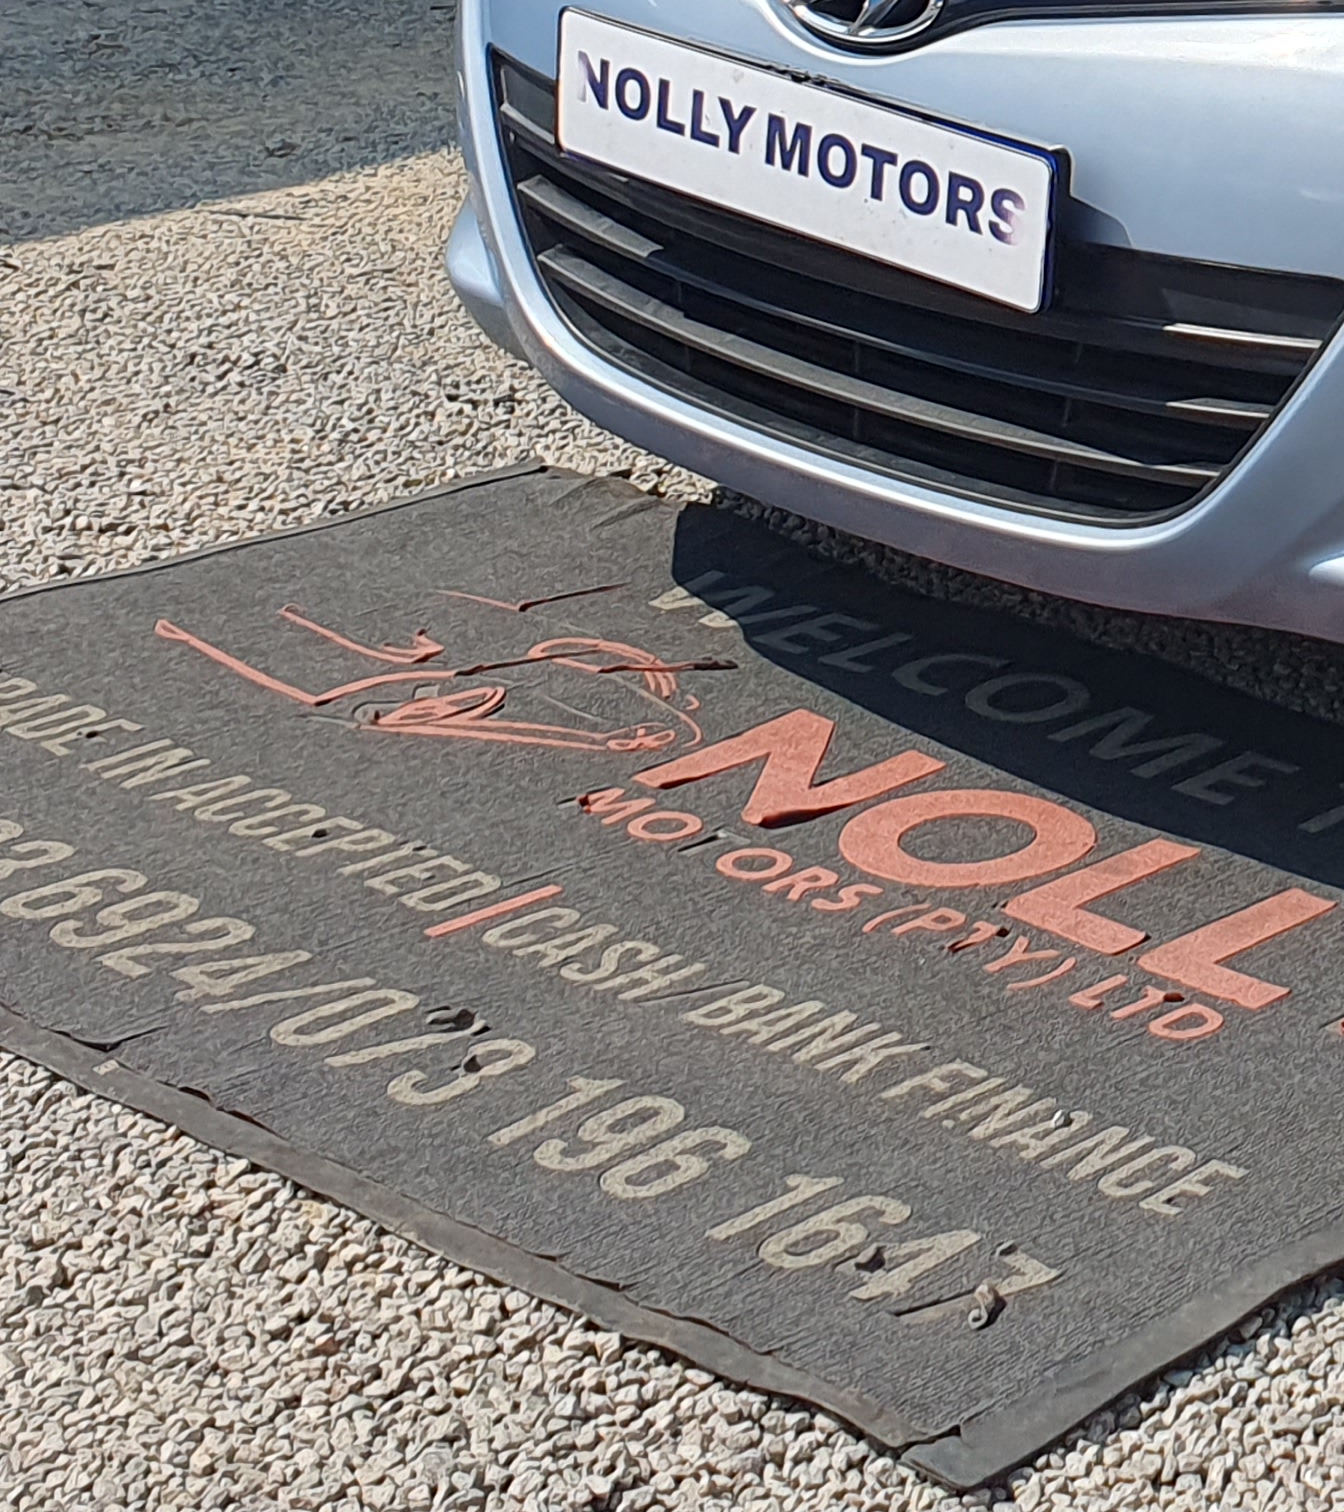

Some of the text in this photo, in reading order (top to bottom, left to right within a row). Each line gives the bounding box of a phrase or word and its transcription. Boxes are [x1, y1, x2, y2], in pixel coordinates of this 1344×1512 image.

[576, 49, 1026, 246] NOLLY MOTORS
[648, 569, 1300, 805] WELCOME
[80, 738, 211, 789] IN
[147, 774, 500, 913] ACCEPTED
[880, 1059, 1250, 1216] FINANCE
[577, 787, 1225, 1040] MOTORS (PTY) LTD
[488, 1074, 752, 1199] 196
